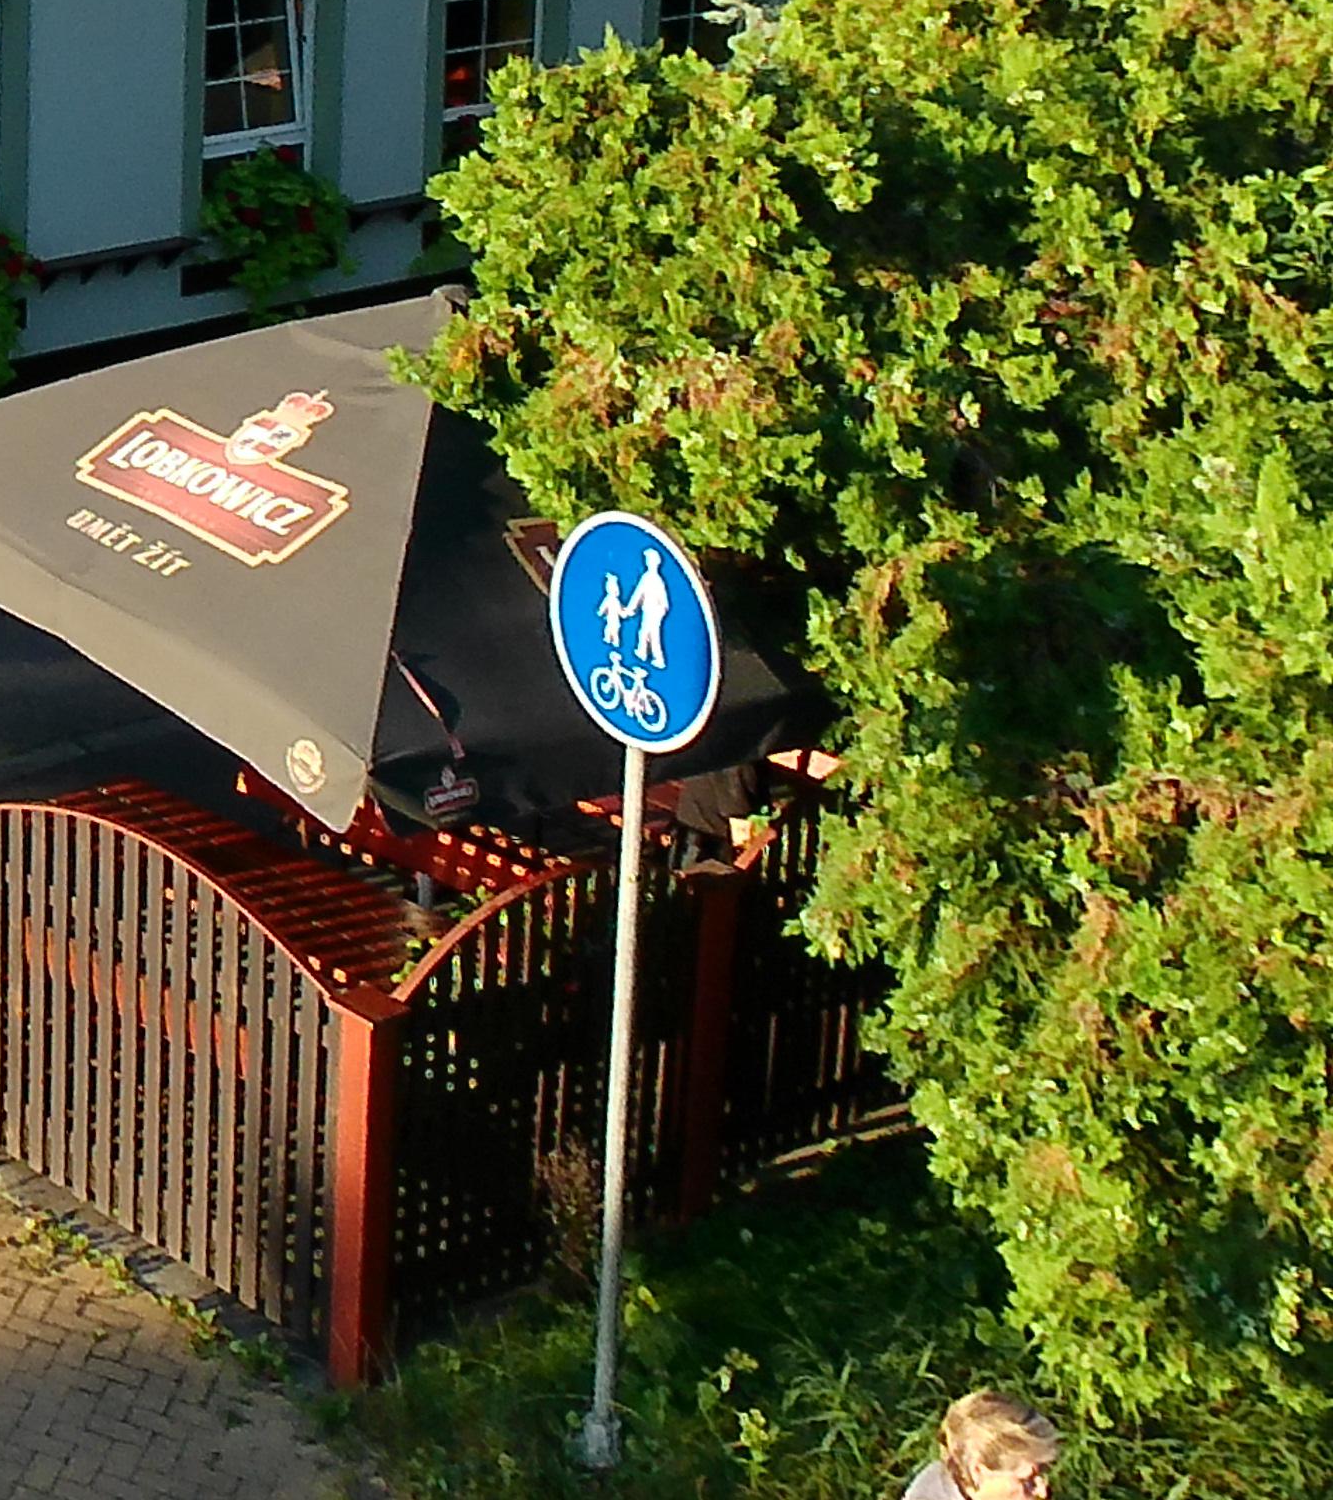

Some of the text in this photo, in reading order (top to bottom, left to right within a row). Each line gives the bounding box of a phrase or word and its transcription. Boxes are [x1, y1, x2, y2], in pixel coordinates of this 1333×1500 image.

[106, 430, 315, 536] LOBKOWICZ
[66, 509, 193, 577] UMĚT ŽÍT
